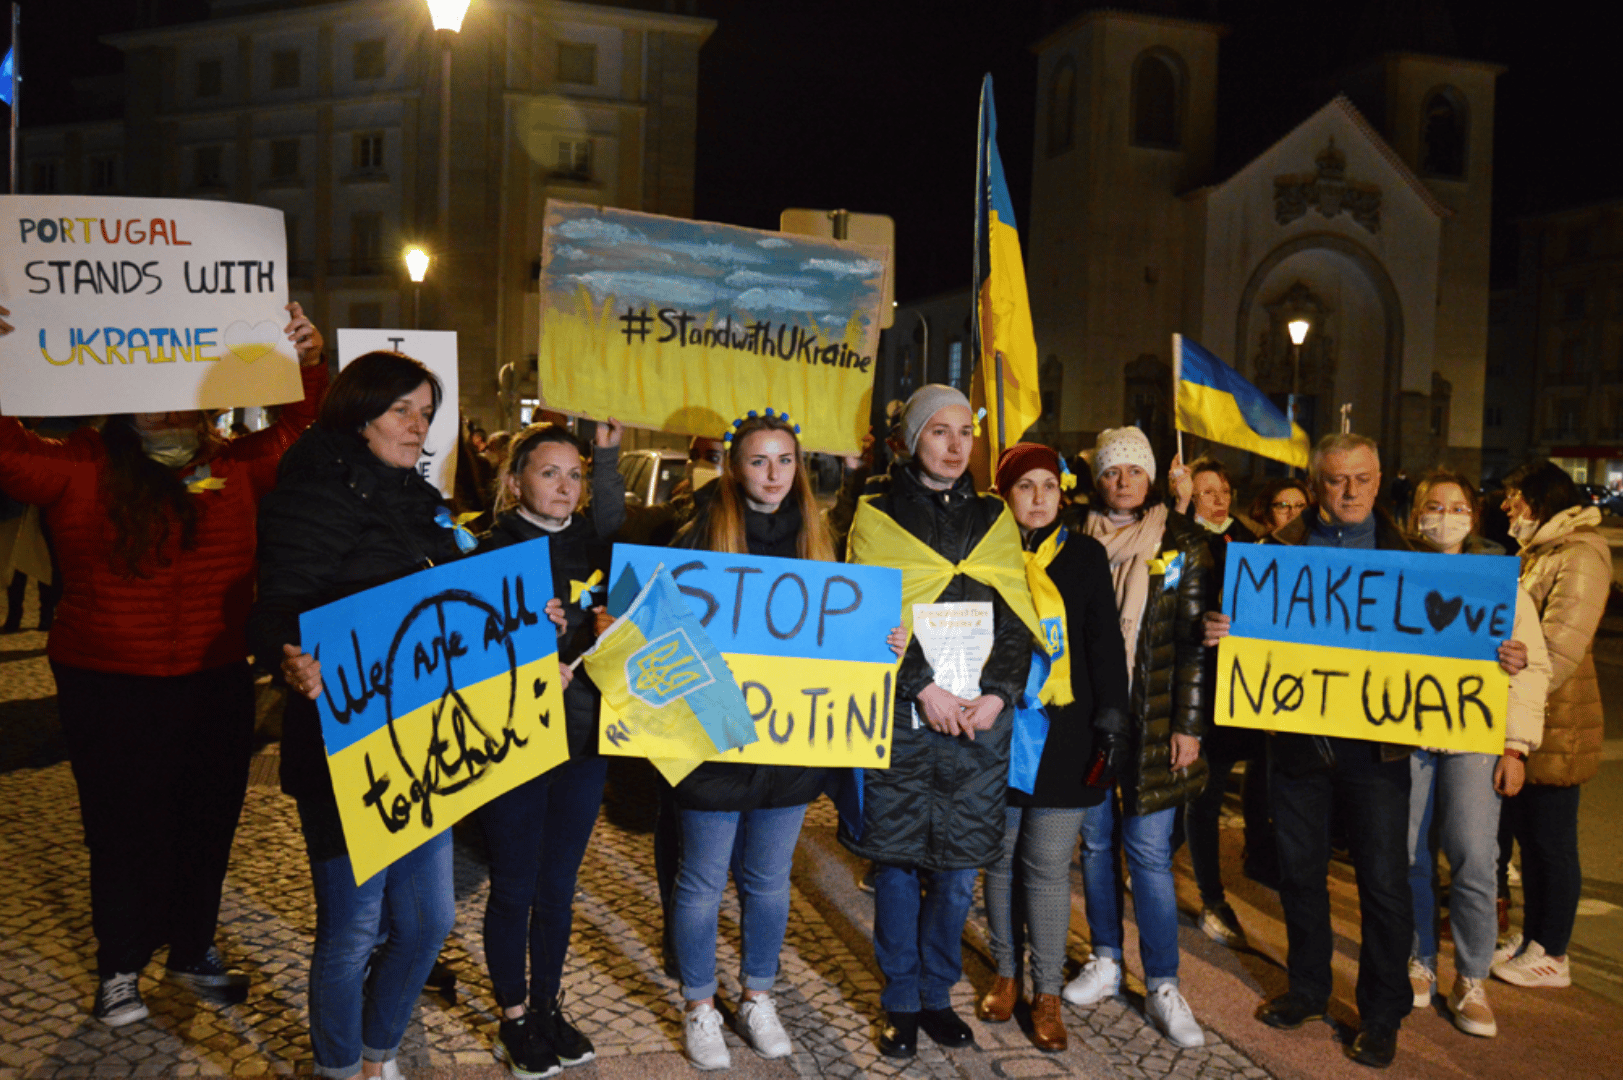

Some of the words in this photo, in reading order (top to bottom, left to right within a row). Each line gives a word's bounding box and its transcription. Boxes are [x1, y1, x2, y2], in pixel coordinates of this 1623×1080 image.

[19, 218, 192, 246] PORTUGAL
[25, 260, 162, 295] STANDS
[184, 260, 275, 294] WITH
[39, 327, 221, 366] UKRAINE
[671, 561, 863, 647] STOP
[1232, 556, 1385, 633] MAKE
[313, 629, 388, 724] We
[1362, 666, 1493, 733] WAR
